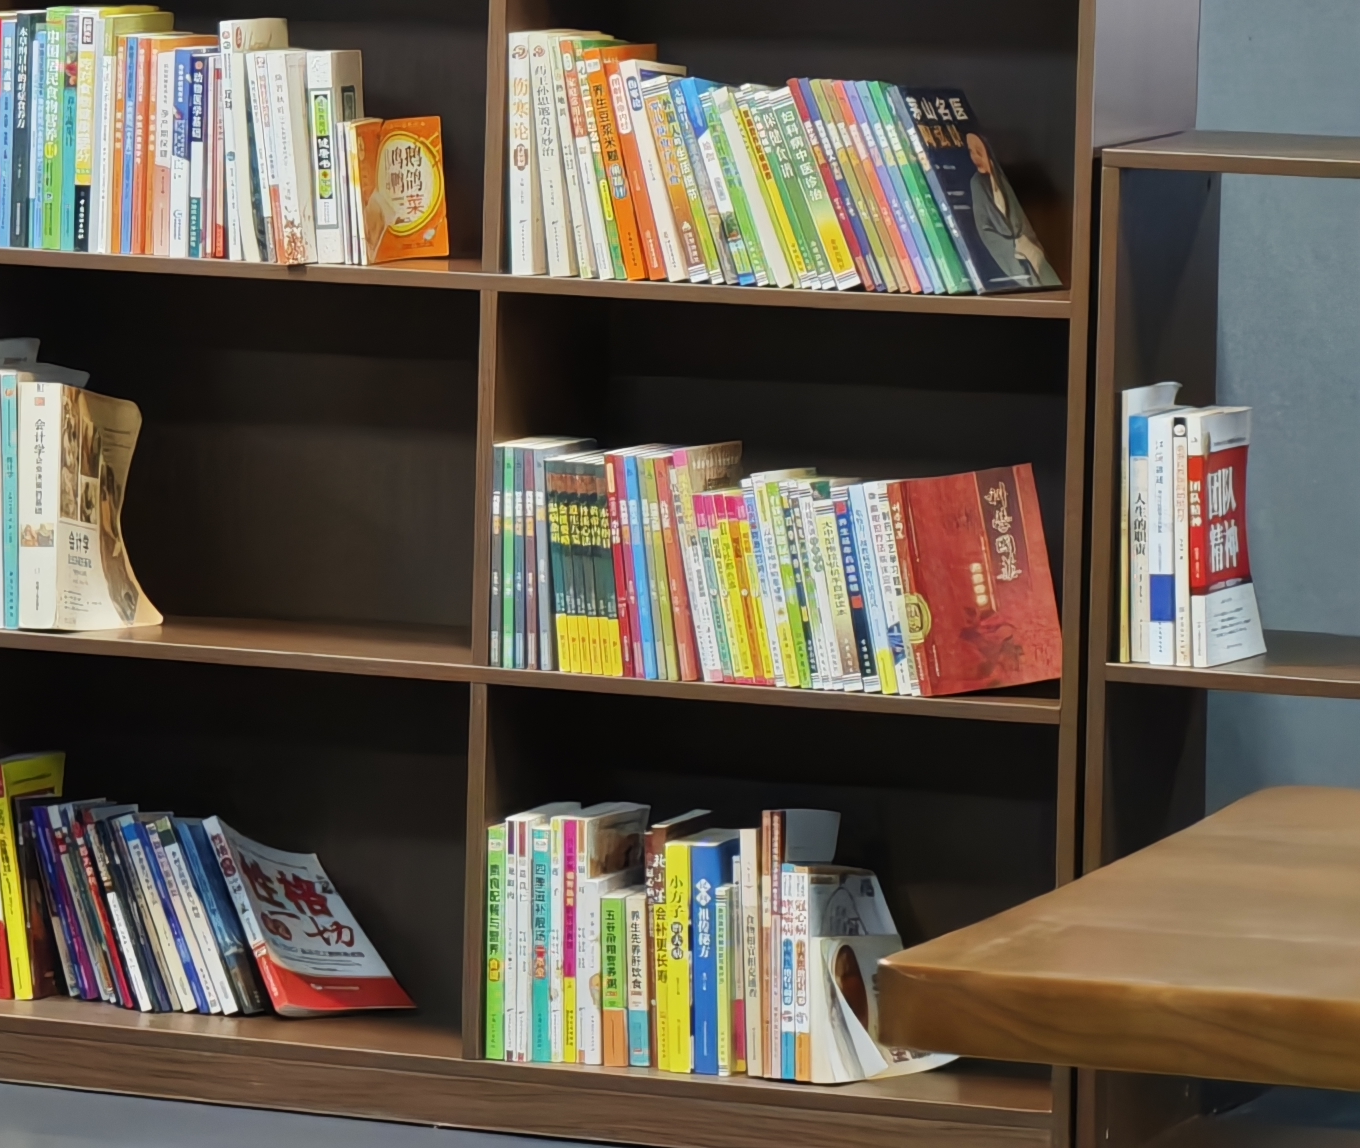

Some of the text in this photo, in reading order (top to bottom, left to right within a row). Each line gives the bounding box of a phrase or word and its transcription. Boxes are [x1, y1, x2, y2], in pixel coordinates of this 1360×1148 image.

[191, 71, 204, 139] 动物医学基础
[512, 77, 529, 140] 伤寒论
[763, 113, 794, 179] 保健食谱
[780, 111, 823, 202] 妇科病中医诊治
[34, 418, 45, 457] 会计学
[1207, 465, 1237, 520] 团队
[1208, 519, 1239, 573] 精神
